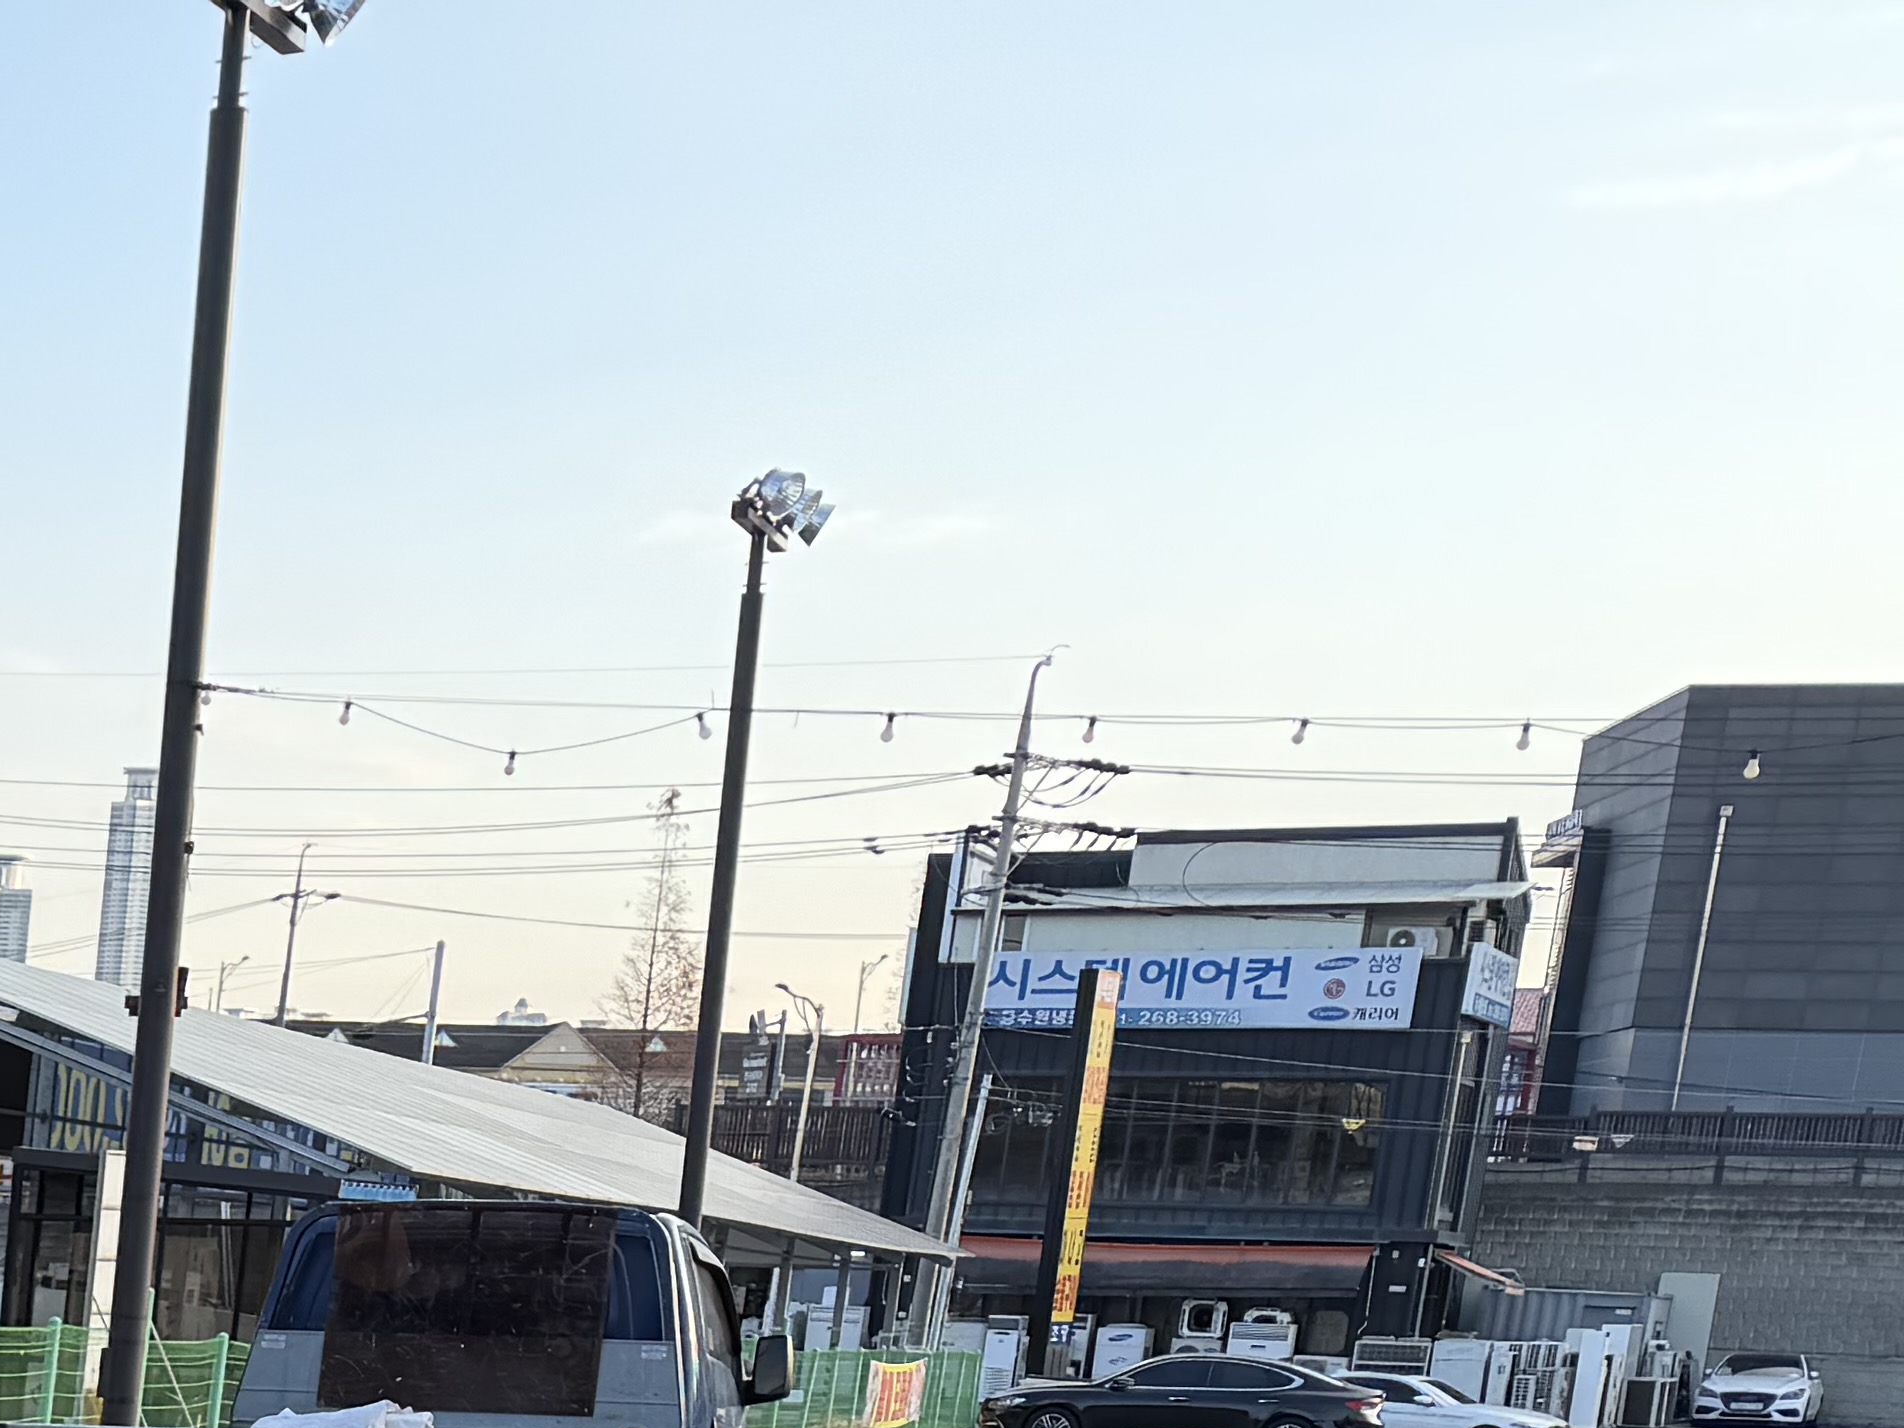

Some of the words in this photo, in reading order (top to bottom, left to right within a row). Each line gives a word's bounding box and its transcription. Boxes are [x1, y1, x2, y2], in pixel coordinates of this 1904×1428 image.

[1369, 953, 1402, 974] 삼성
[1140, 956, 1292, 1000] 에어컨
[1366, 980, 1396, 997] LG
[1352, 1007, 1399, 1021] 캐리어
